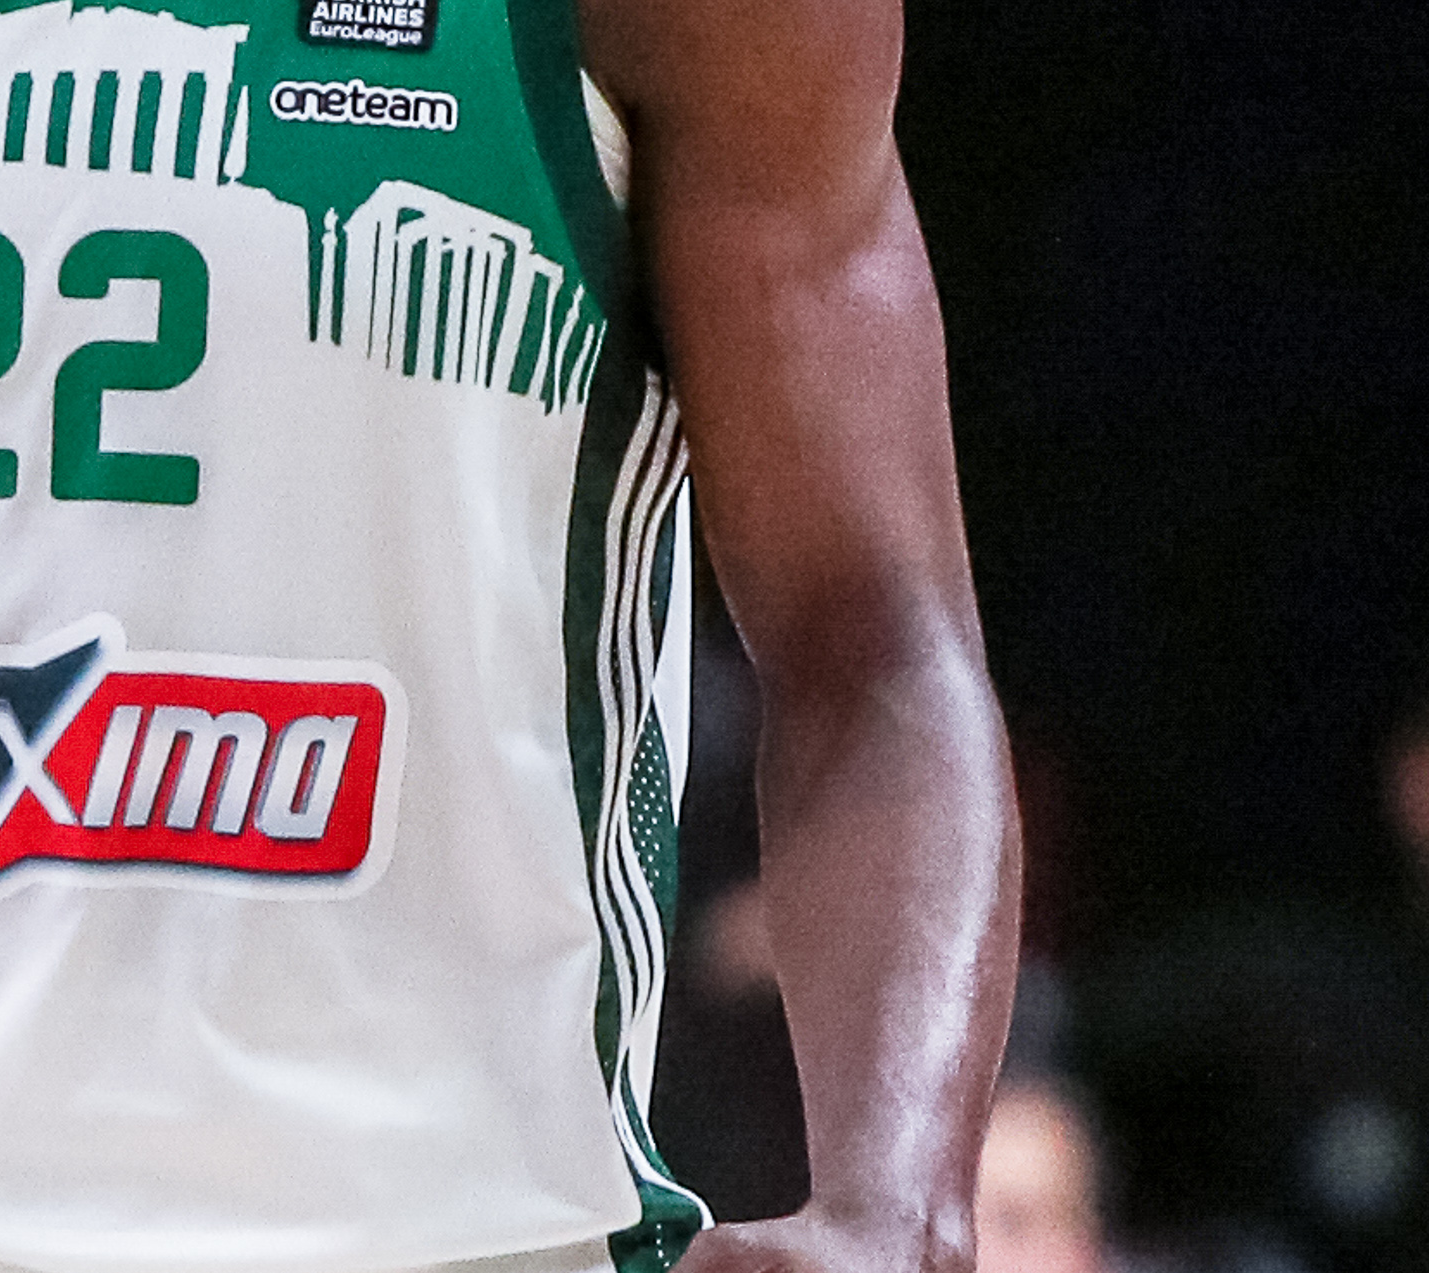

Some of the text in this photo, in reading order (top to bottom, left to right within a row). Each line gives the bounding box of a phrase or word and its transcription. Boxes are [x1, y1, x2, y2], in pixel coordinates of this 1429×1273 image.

[312, 1, 425, 28] AIRLINES
[309, 20, 422, 46] EuroLeague
[275, 85, 452, 125] oneteam
